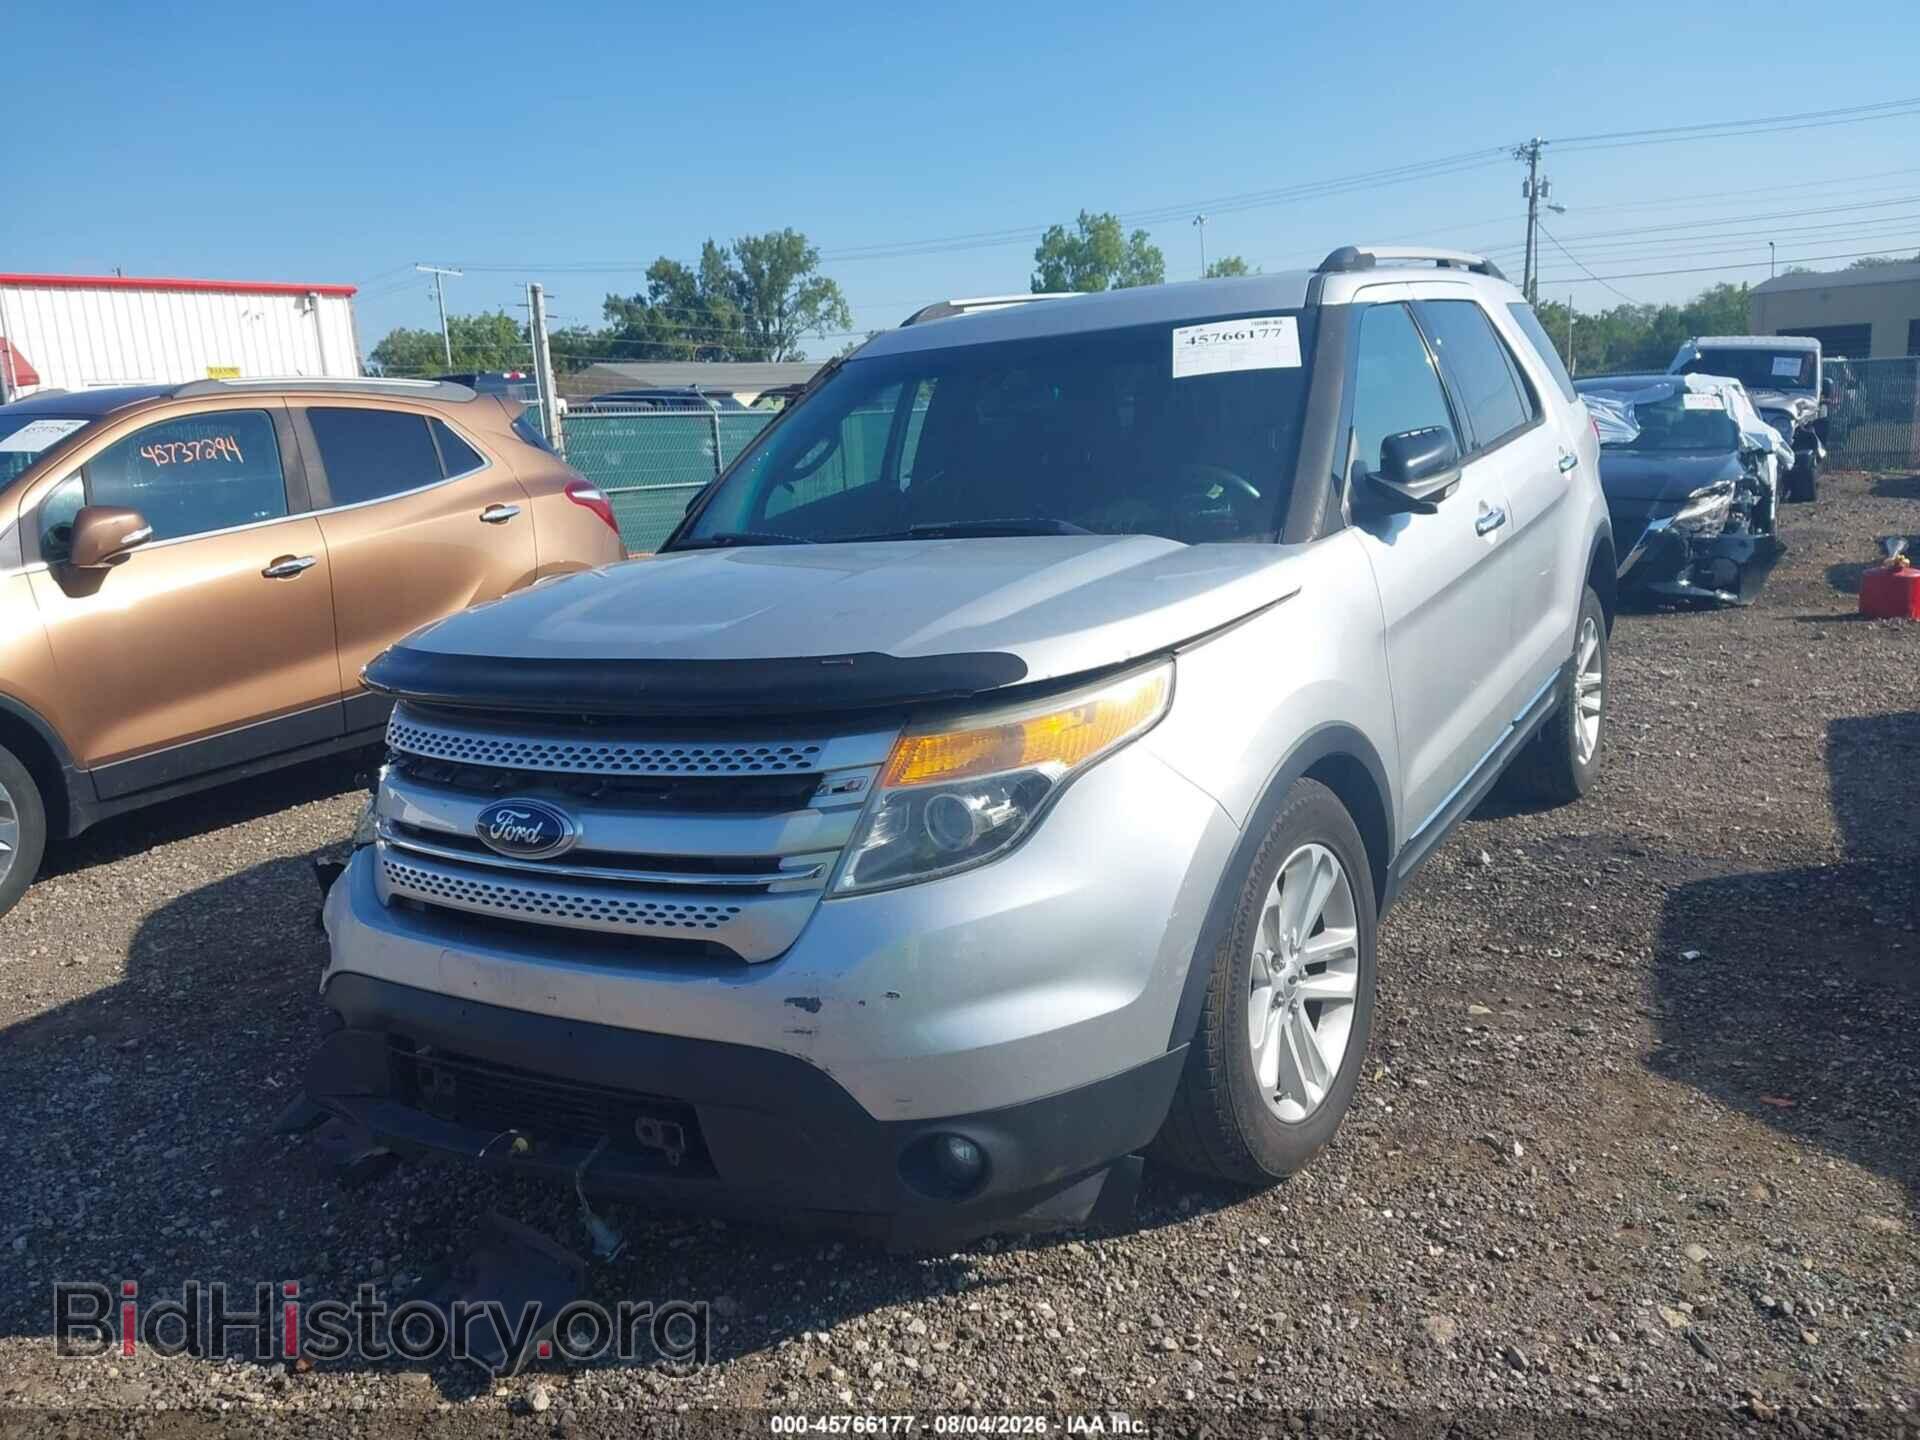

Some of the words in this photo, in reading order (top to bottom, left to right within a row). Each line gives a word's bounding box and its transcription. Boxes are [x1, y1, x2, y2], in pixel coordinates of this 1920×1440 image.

[1185, 328, 1281, 345] 45766177
[140, 436, 244, 467] 45737294
[490, 809, 544, 844] Ford
